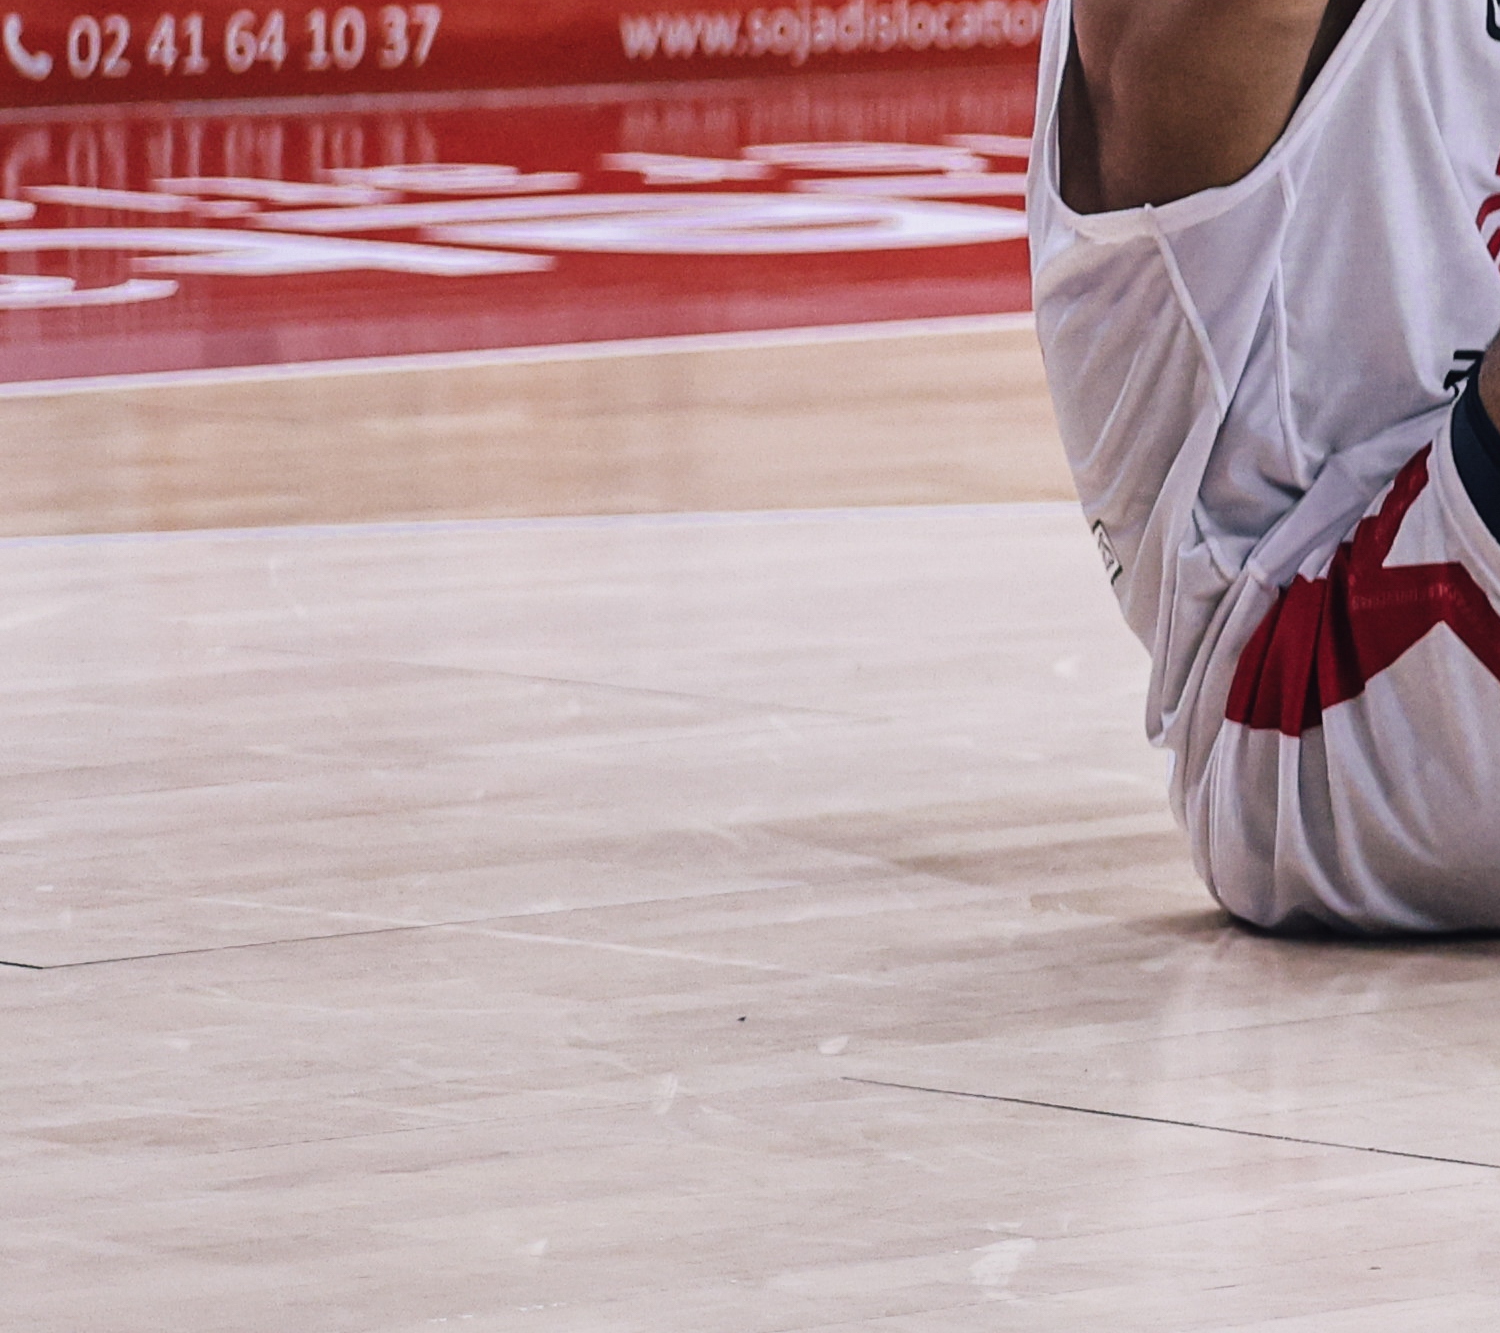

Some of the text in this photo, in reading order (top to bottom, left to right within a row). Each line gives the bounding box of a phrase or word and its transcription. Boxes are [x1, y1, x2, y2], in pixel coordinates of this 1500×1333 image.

[67, 4, 441, 76] 02 41 64 10 37
